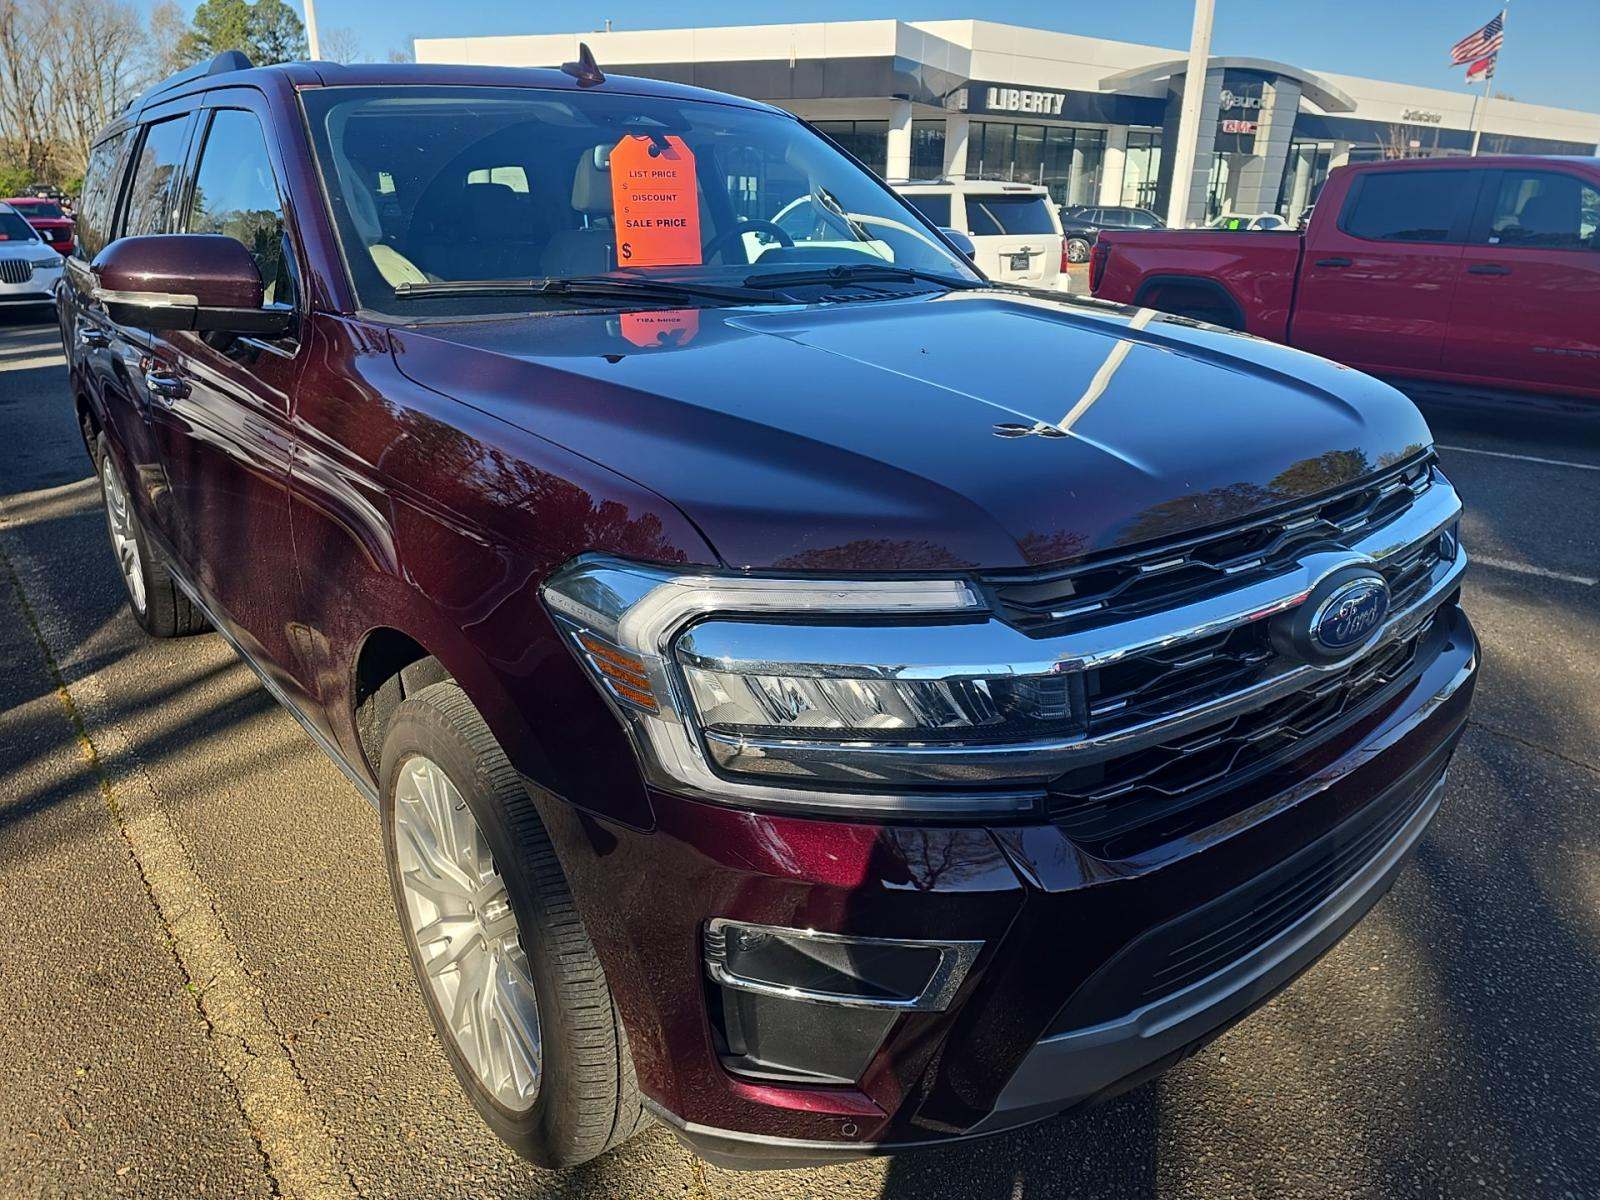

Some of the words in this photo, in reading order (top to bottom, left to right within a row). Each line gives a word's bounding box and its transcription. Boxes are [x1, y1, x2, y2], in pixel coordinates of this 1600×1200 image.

[986, 87, 1066, 115] LIBERTY
[629, 170, 648, 178] LIST
[651, 170, 678, 178] PRICE
[632, 194, 678, 202] DISCOUNT
[626, 219, 653, 228] SALE
[656, 218, 687, 228] PRICE
[621, 241, 632, 259] $
[1335, 591, 1380, 641] Ford
